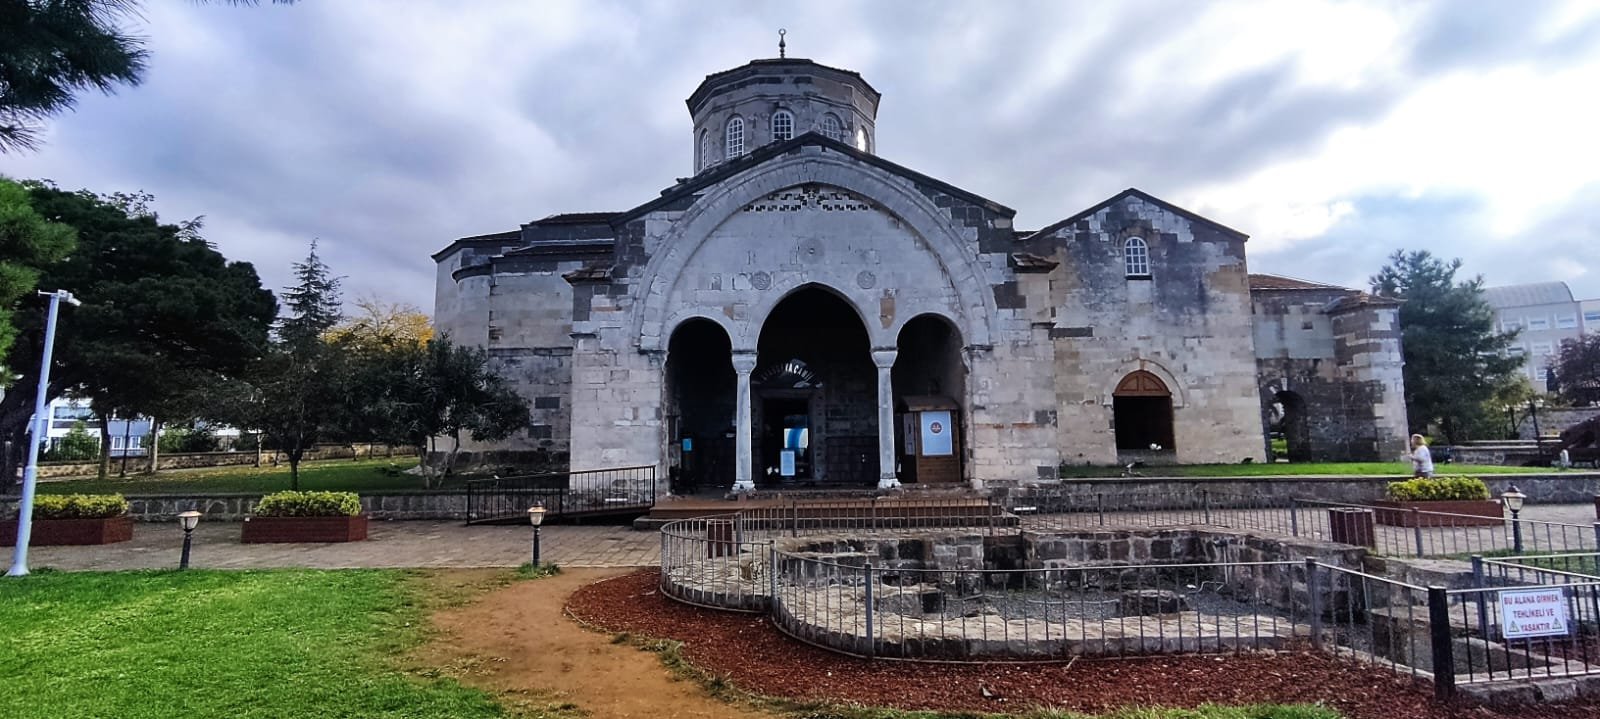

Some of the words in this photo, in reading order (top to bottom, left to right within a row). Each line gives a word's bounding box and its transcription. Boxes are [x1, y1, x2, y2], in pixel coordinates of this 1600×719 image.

[1504, 597, 1513, 605] BU
[1514, 596, 1535, 604] ALANA
[1537, 594, 1558, 603] GİRMEK
[1513, 609, 1545, 618] TEHLİKELİ
[1546, 608, 1554, 616] VE
[1521, 623, 1550, 632] YASAKTIR
